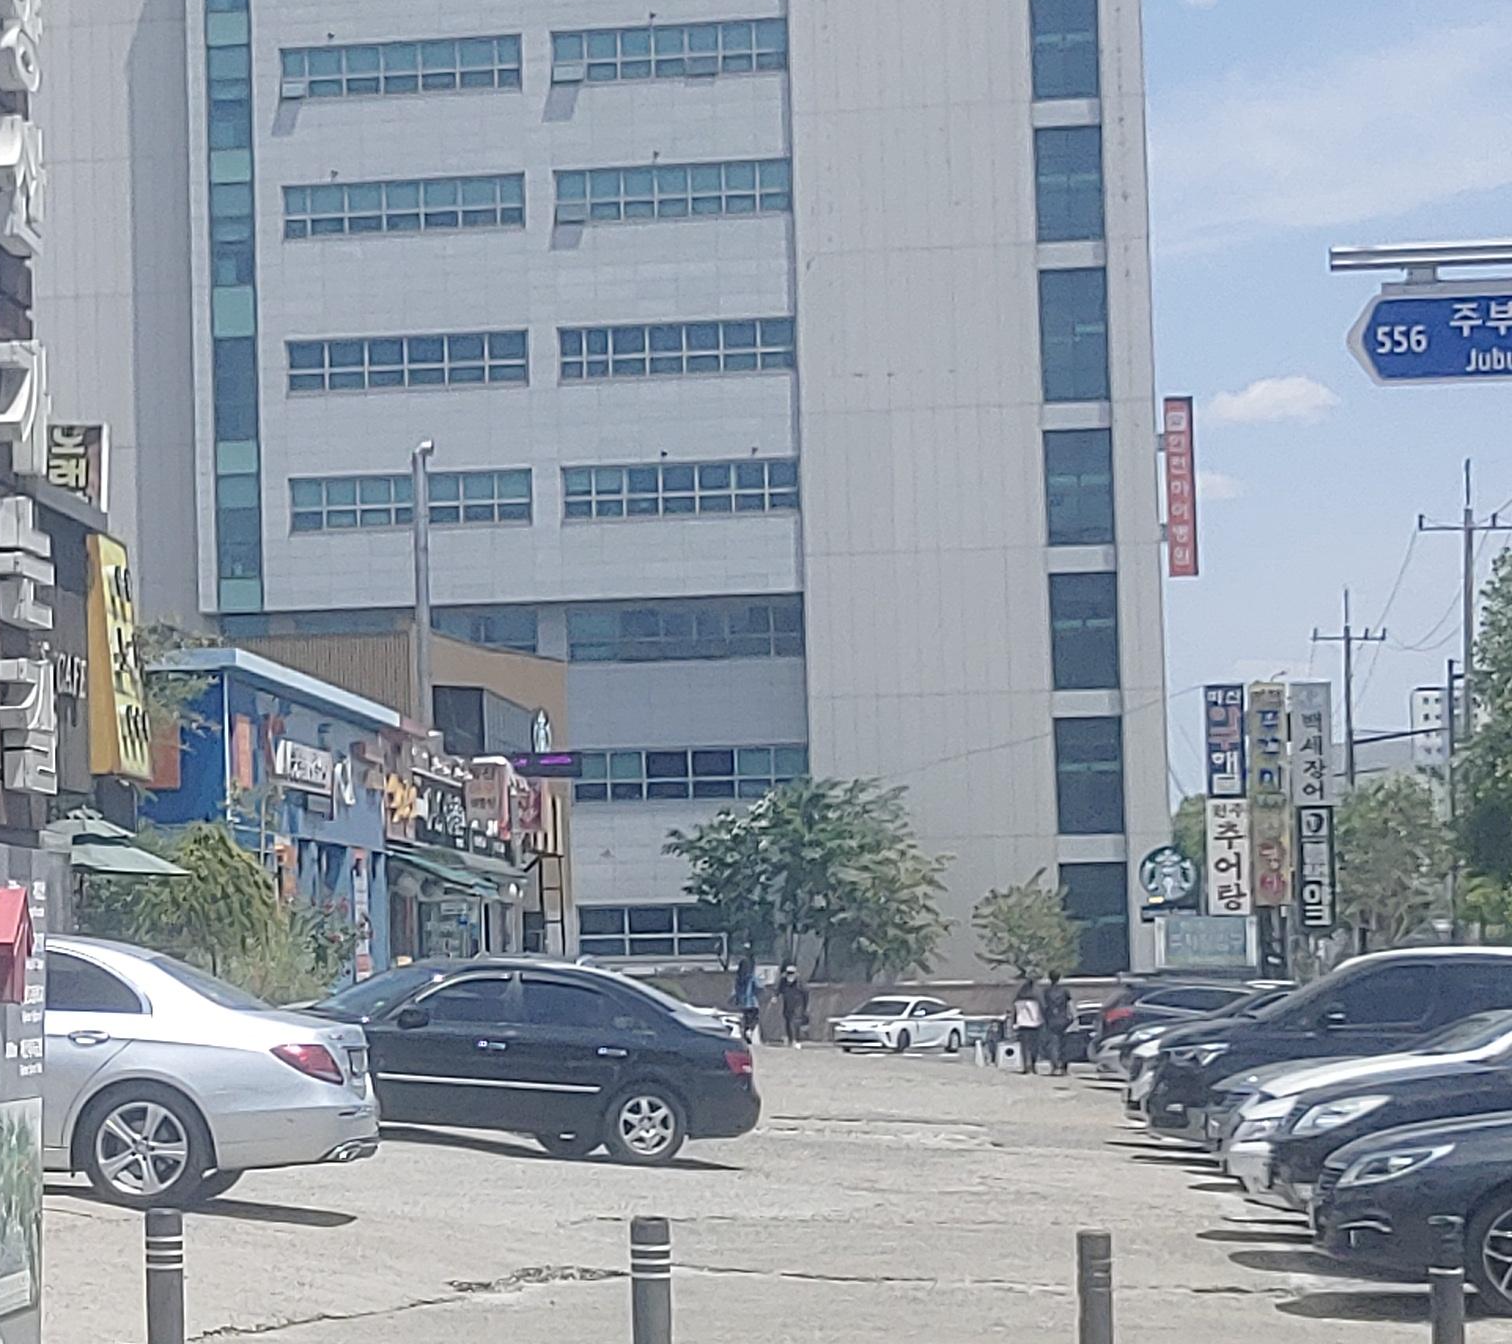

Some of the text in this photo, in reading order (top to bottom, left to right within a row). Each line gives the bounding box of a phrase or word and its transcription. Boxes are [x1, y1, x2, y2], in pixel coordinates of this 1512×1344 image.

[1375, 325, 1428, 355] 556
[49, 426, 89, 504] 노래
[57, 652, 88, 700] CAFE
[1213, 821, 1248, 912] 추어탕
